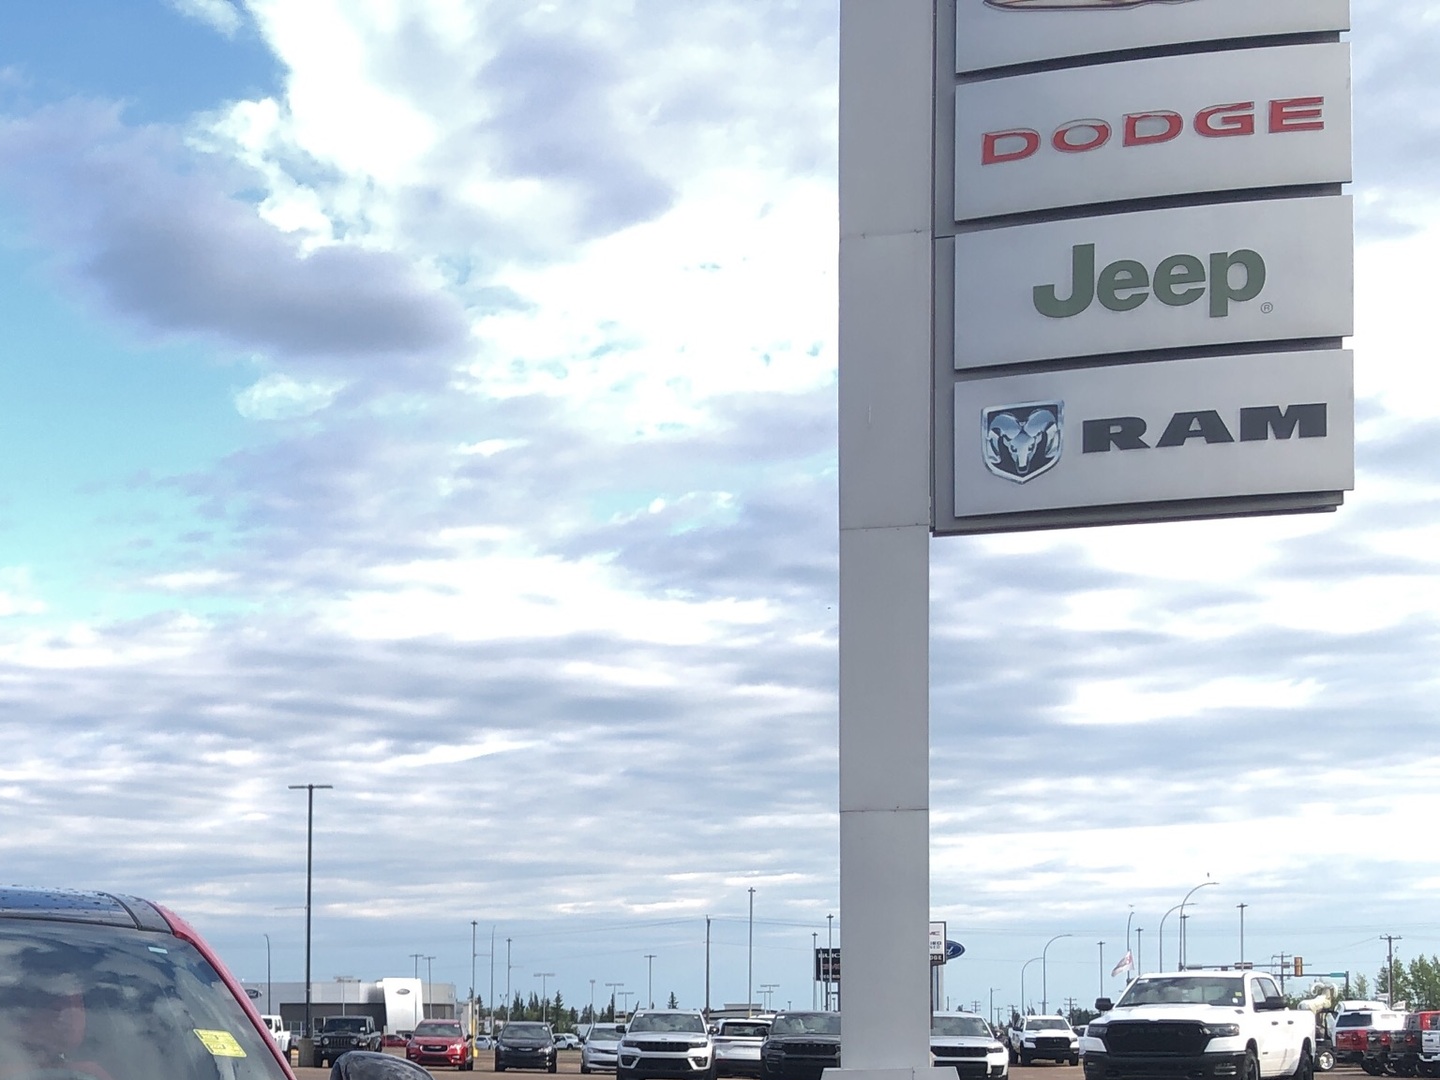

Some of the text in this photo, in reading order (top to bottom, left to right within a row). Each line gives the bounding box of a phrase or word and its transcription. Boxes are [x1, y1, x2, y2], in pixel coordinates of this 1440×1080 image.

[982, 96, 1324, 165] DODGE
[1033, 243, 1266, 318] Jeep
[1083, 403, 1327, 453] RAM
